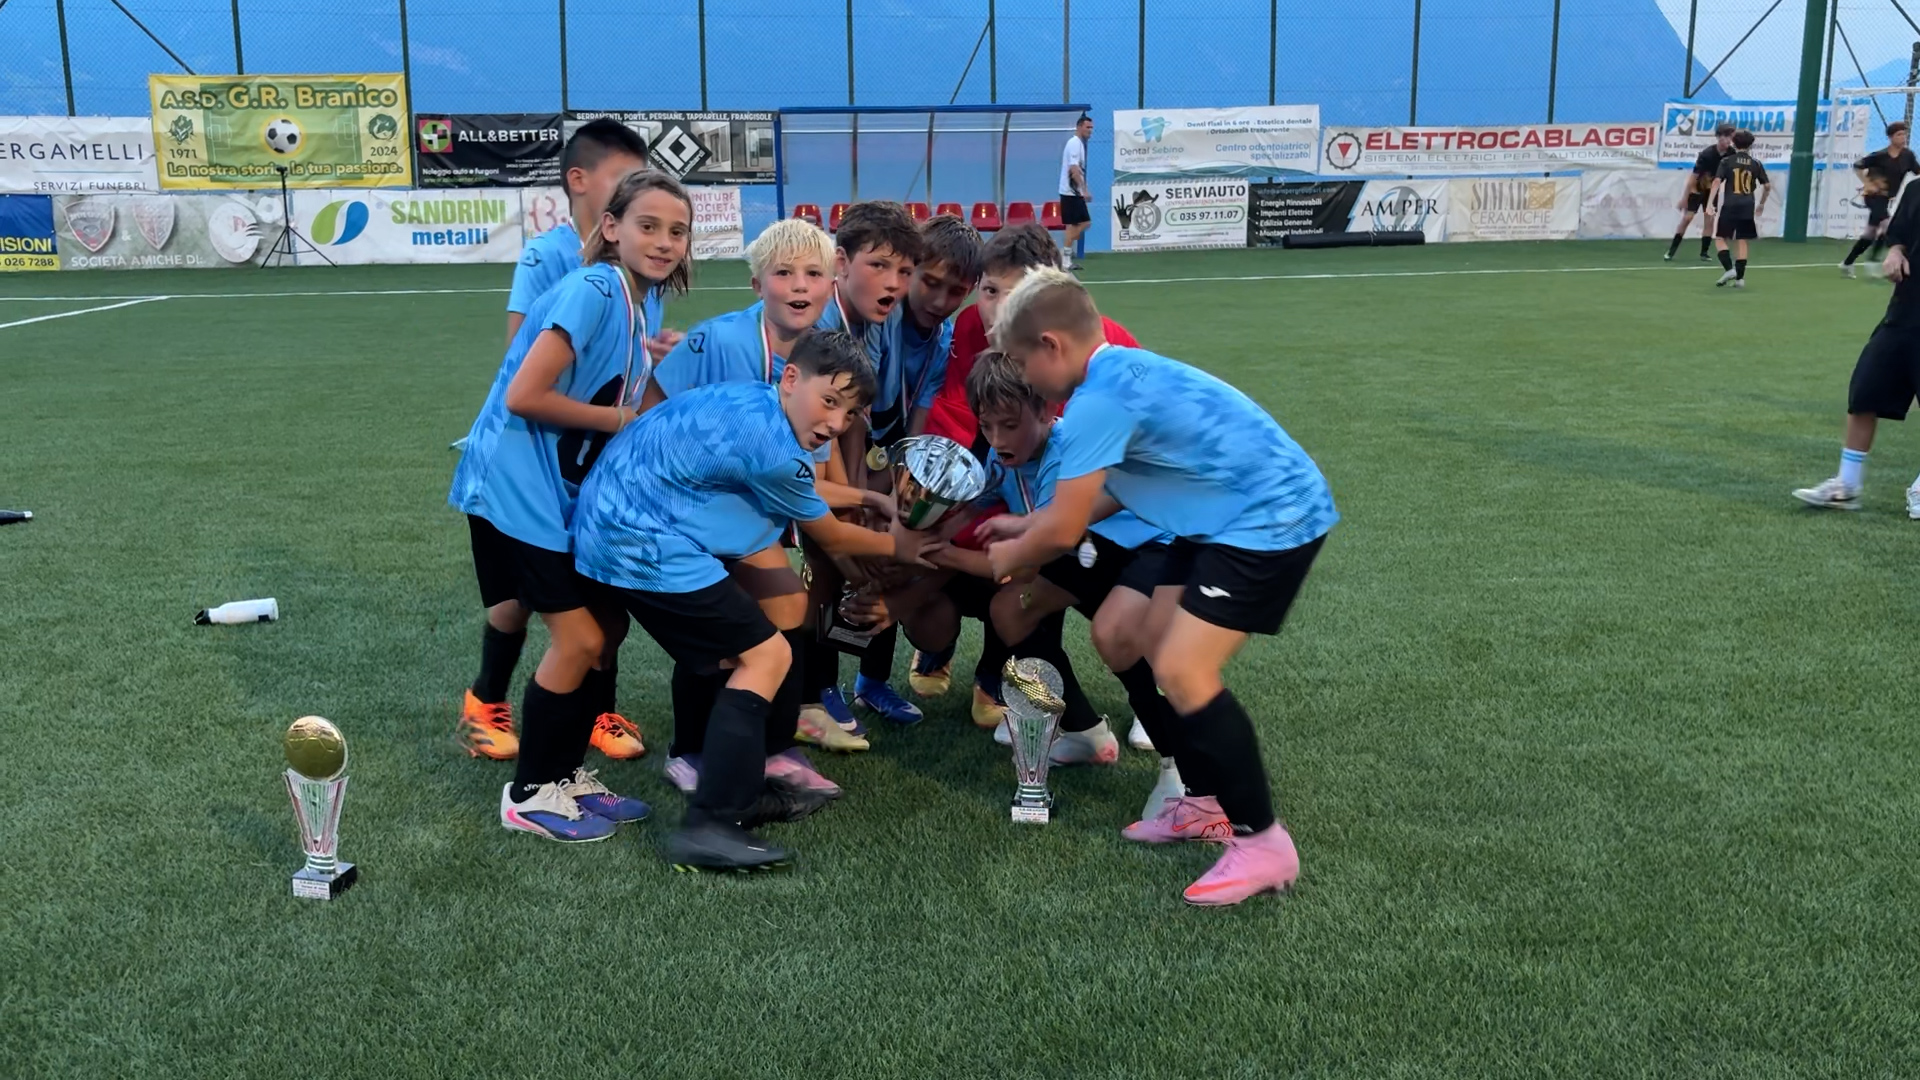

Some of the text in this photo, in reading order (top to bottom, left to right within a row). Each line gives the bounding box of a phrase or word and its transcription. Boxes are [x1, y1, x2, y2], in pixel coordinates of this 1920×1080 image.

[160, 83, 398, 109] A.S.D. G.R. Branico
[1186, 120, 1206, 128] Denti
[1286, 117, 1313, 125] dentale
[458, 129, 559, 142] ALL&BETTER
[1210, 127, 1249, 135] Ortodonzia
[1365, 127, 1655, 150] ELETTROCABLAGGI
[370, 146, 398, 156] 2024
[1119, 145, 1184, 156] Dental Sebino
[1215, 142, 1310, 152] Centro odontoiatrico
[169, 149, 198, 159] 1971
[1250, 151, 1309, 161] specializzato
[1364, 154, 1420, 162] SISTEMI
[1428, 153, 1496, 162] ELETTRICI
[1504, 152, 1531, 161] PER
[167, 159, 404, 177] La nostra stori la tua passione.
[422, 168, 452, 177] Noleggio
[474, 167, 499, 176] furgoni
[34, 182, 146, 190] SERVIZI FUNEBRI
[1732, 167, 1753, 195] 10
[1165, 185, 1246, 199] SERVIAUTO
[1286, 198, 1323, 207] Rinnovabili
[391, 199, 506, 225] SANDRINI
[1180, 210, 1239, 221] 035 97.11.07
[1260, 208, 1313, 218] Impianti Elettrici
[1259, 218, 1313, 227] Edilizia Generale
[1470, 210, 1551, 225] CERAMICHE
[412, 228, 489, 246] metalli
[4, 257, 55, 267] 026 7288
[71, 253, 124, 267] SOCIETÀ
[132, 254, 182, 267] AMICHE
